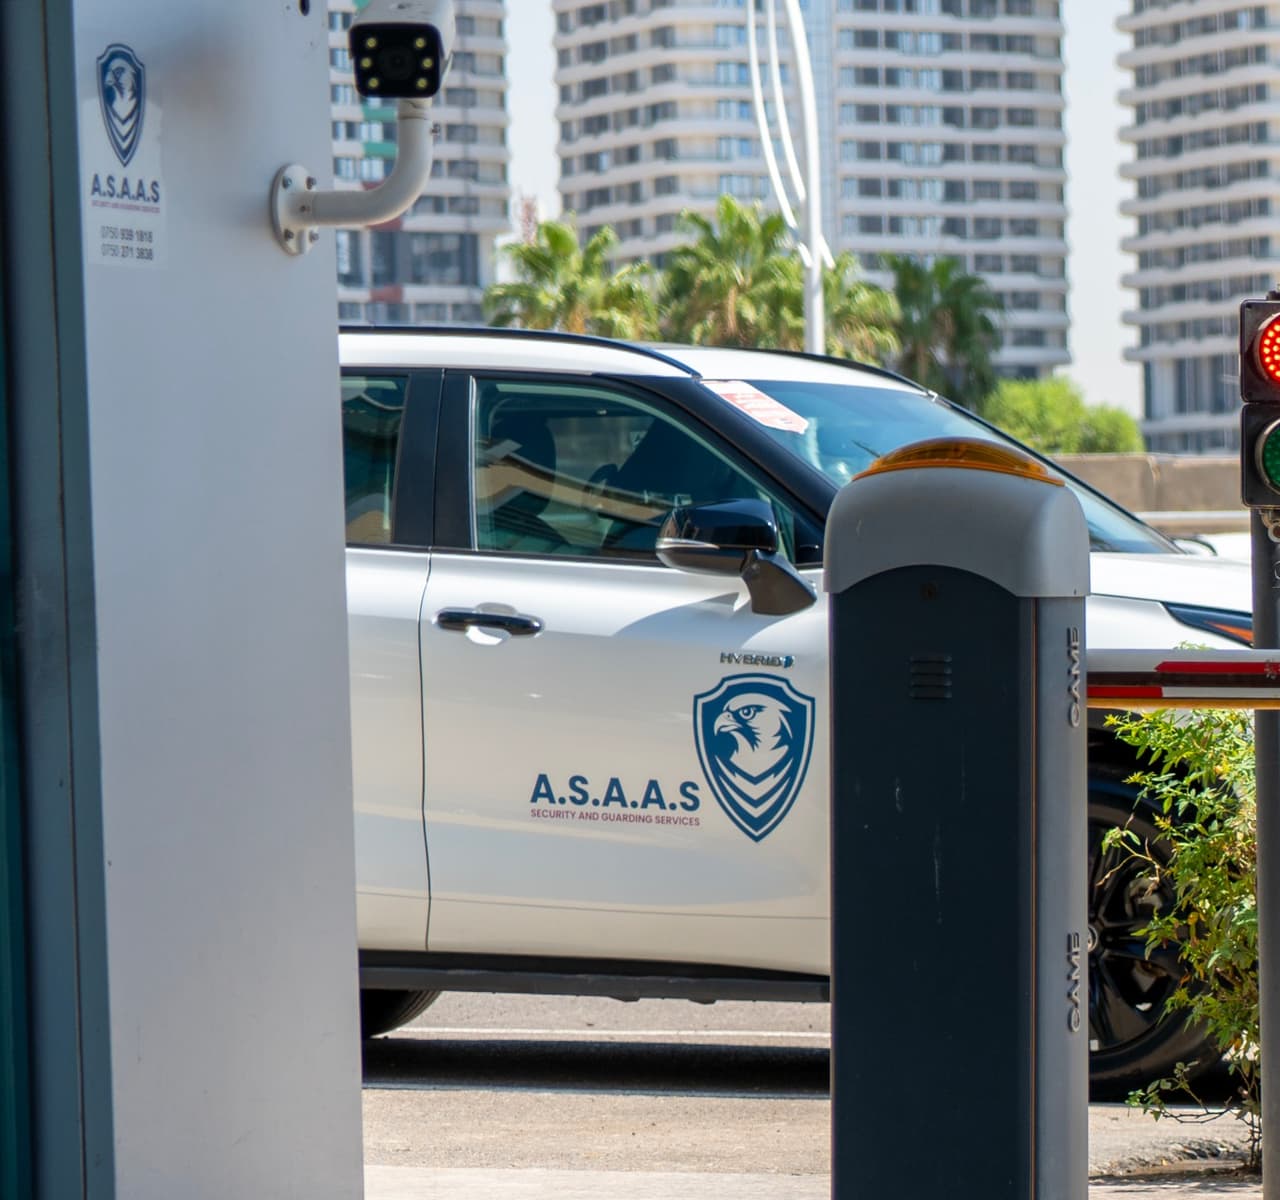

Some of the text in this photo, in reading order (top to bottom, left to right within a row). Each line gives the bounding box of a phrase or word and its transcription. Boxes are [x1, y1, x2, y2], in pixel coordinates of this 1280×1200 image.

[91, 173, 160, 203] A.S.A.A.S
[720, 652, 783, 667] HYBRID
[1068, 626, 1081, 727] CAME
[530, 773, 701, 812] A.S.A.A.S
[530, 808, 701, 826] SECURITY AND GUARDING SERVICES
[1068, 932, 1081, 1032] CAME
